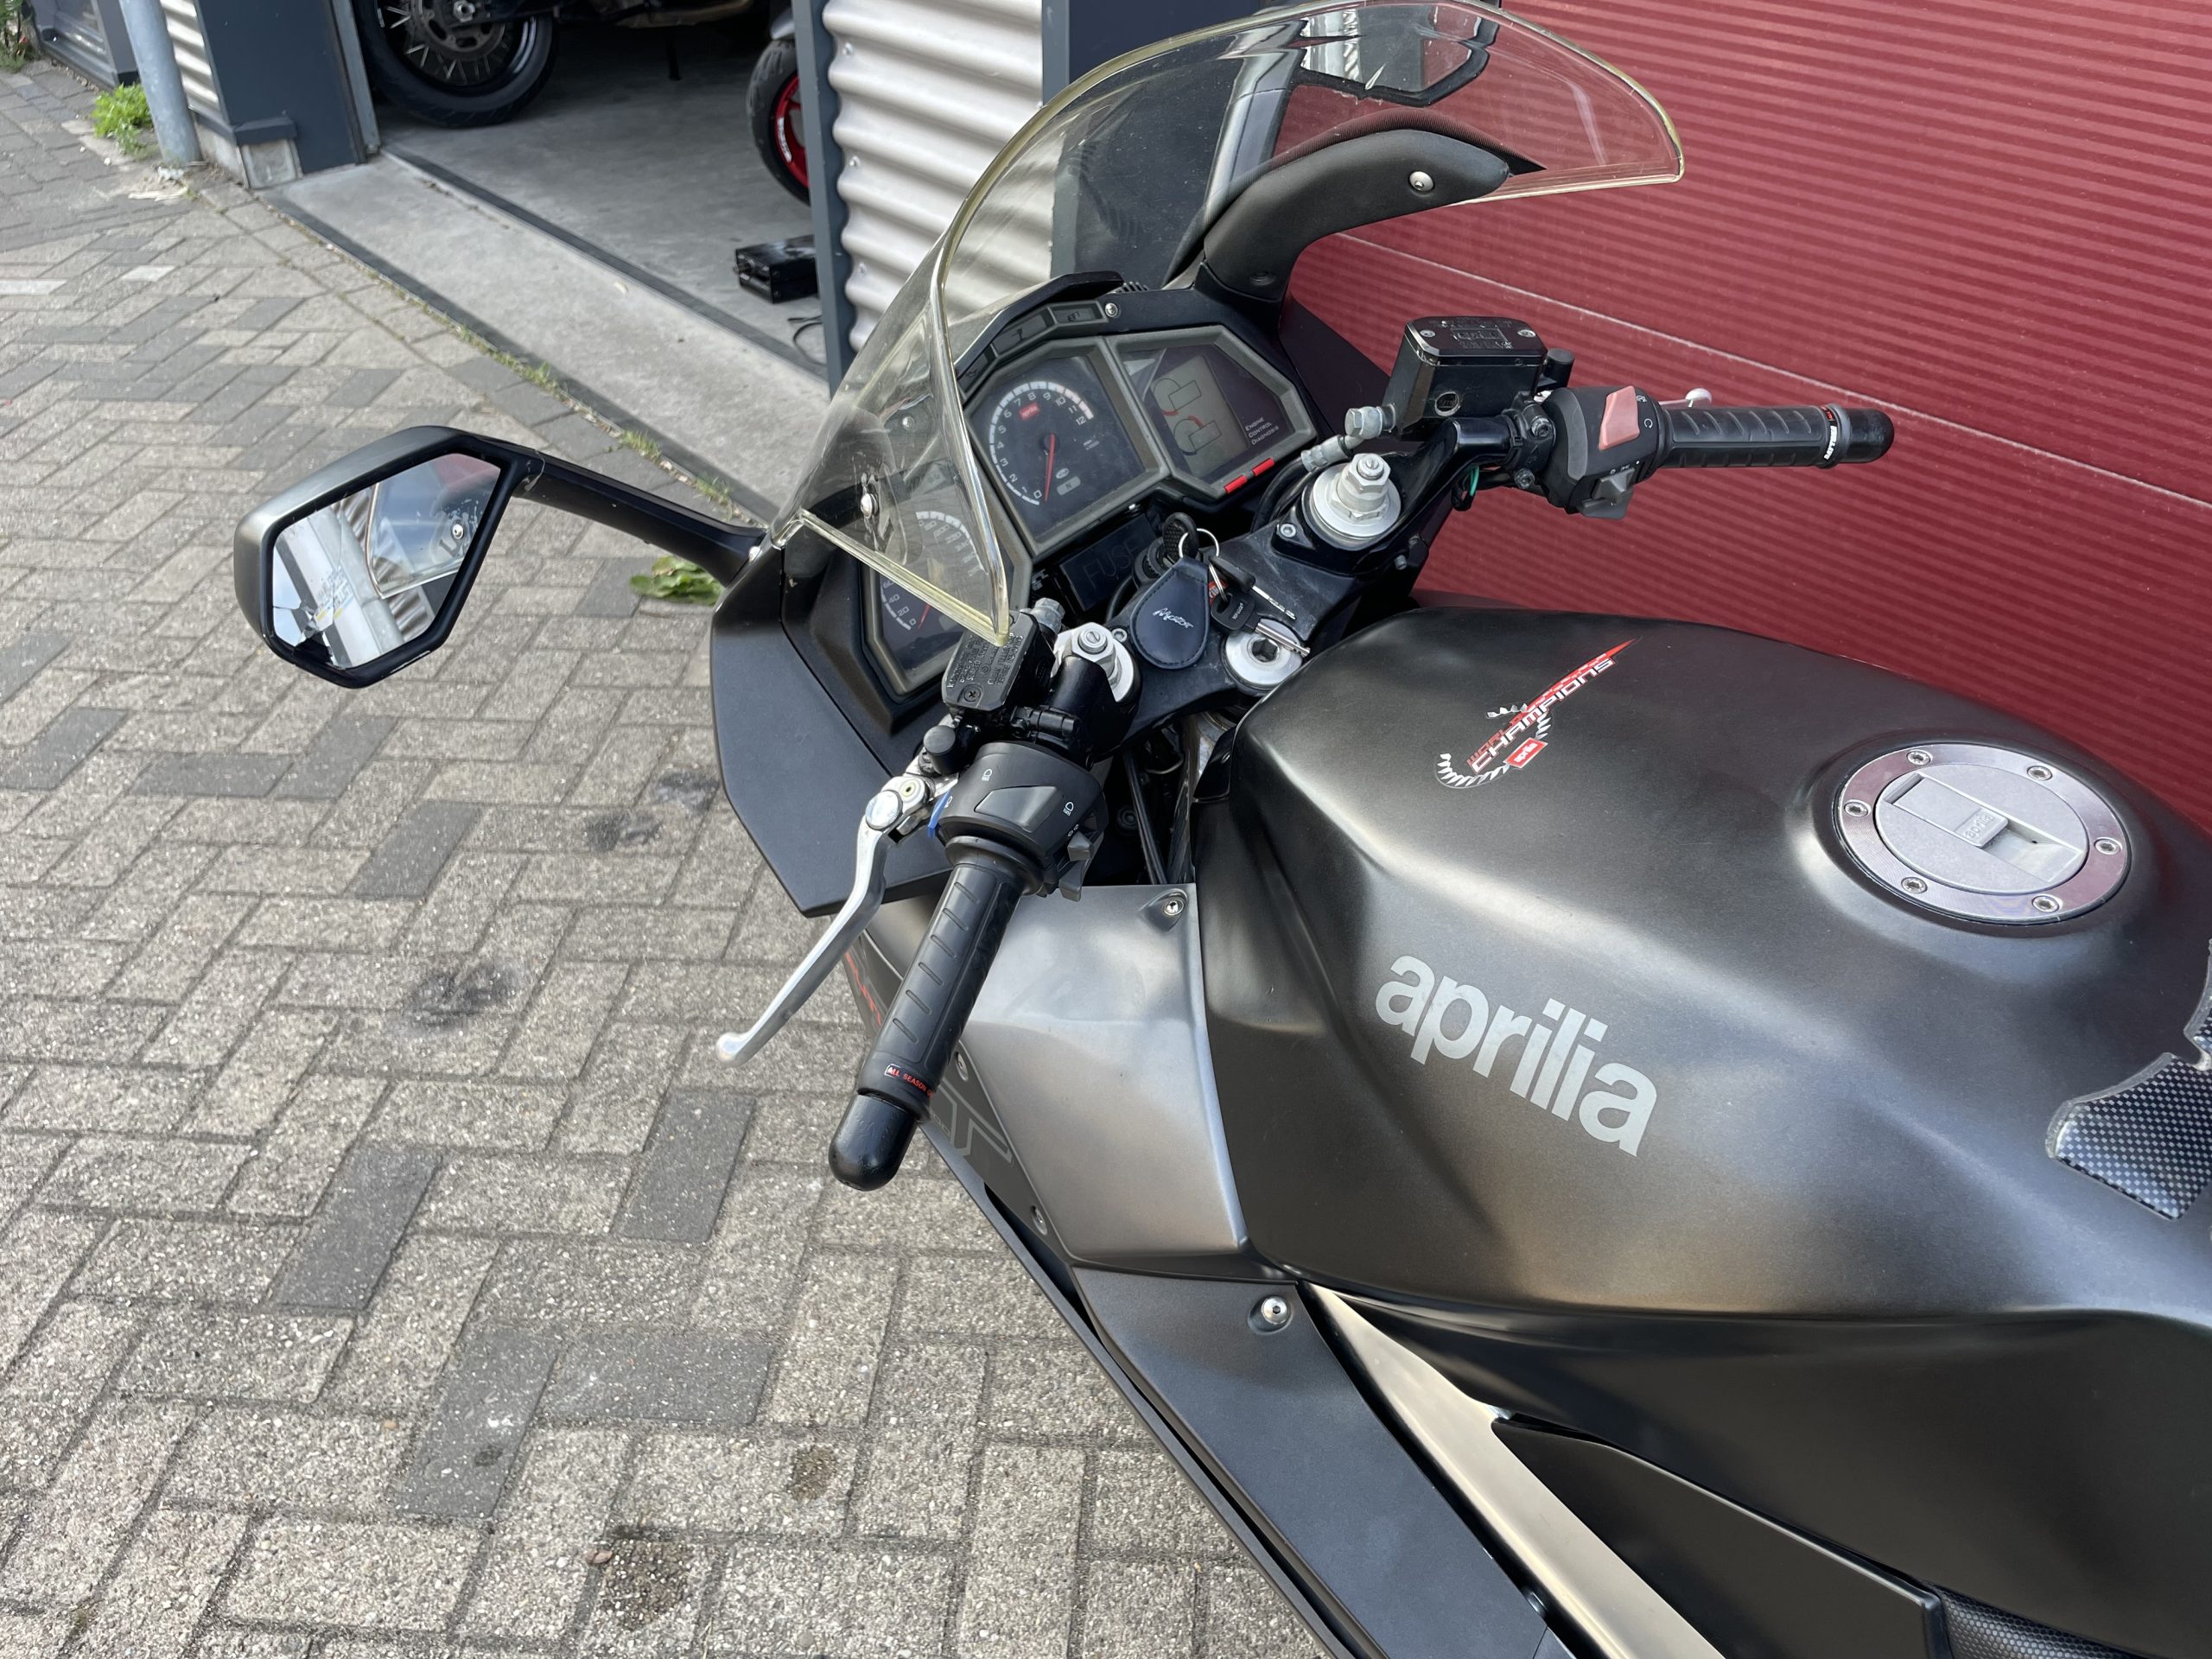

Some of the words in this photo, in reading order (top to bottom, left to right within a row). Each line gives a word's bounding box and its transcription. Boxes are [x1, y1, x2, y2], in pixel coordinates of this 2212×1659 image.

[1248, 423, 1272, 438] CONTROL
[888, 594, 899, 603] 40
[897, 606, 910, 617] 20
[1152, 607, 1194, 629] Motor
[1471, 658, 1614, 773] CHAMPIONS
[1376, 956, 1657, 1157] aprilia
[903, 1073, 926, 1091] SEASON
